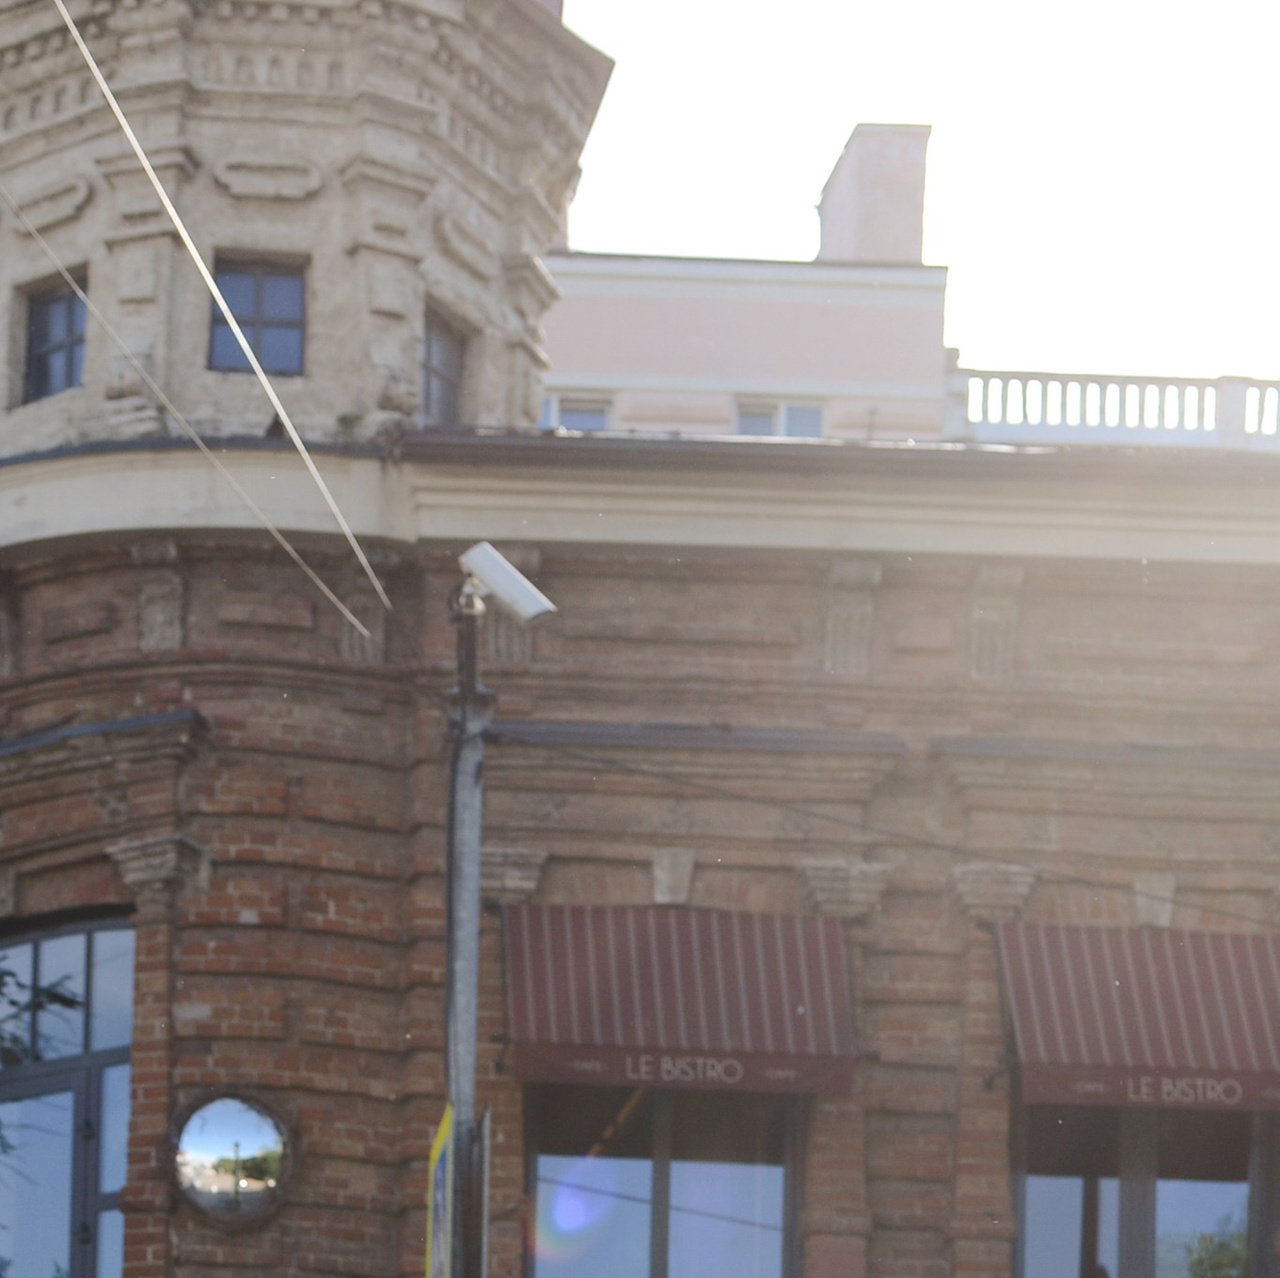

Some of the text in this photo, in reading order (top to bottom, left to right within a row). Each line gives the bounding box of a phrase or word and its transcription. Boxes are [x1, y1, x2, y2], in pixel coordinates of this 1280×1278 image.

[625, 1054, 654, 1080] LE
[660, 1055, 744, 1083] BISTRO
[1127, 1075, 1154, 1102] LE
[1160, 1076, 1243, 1105] BISTRO
